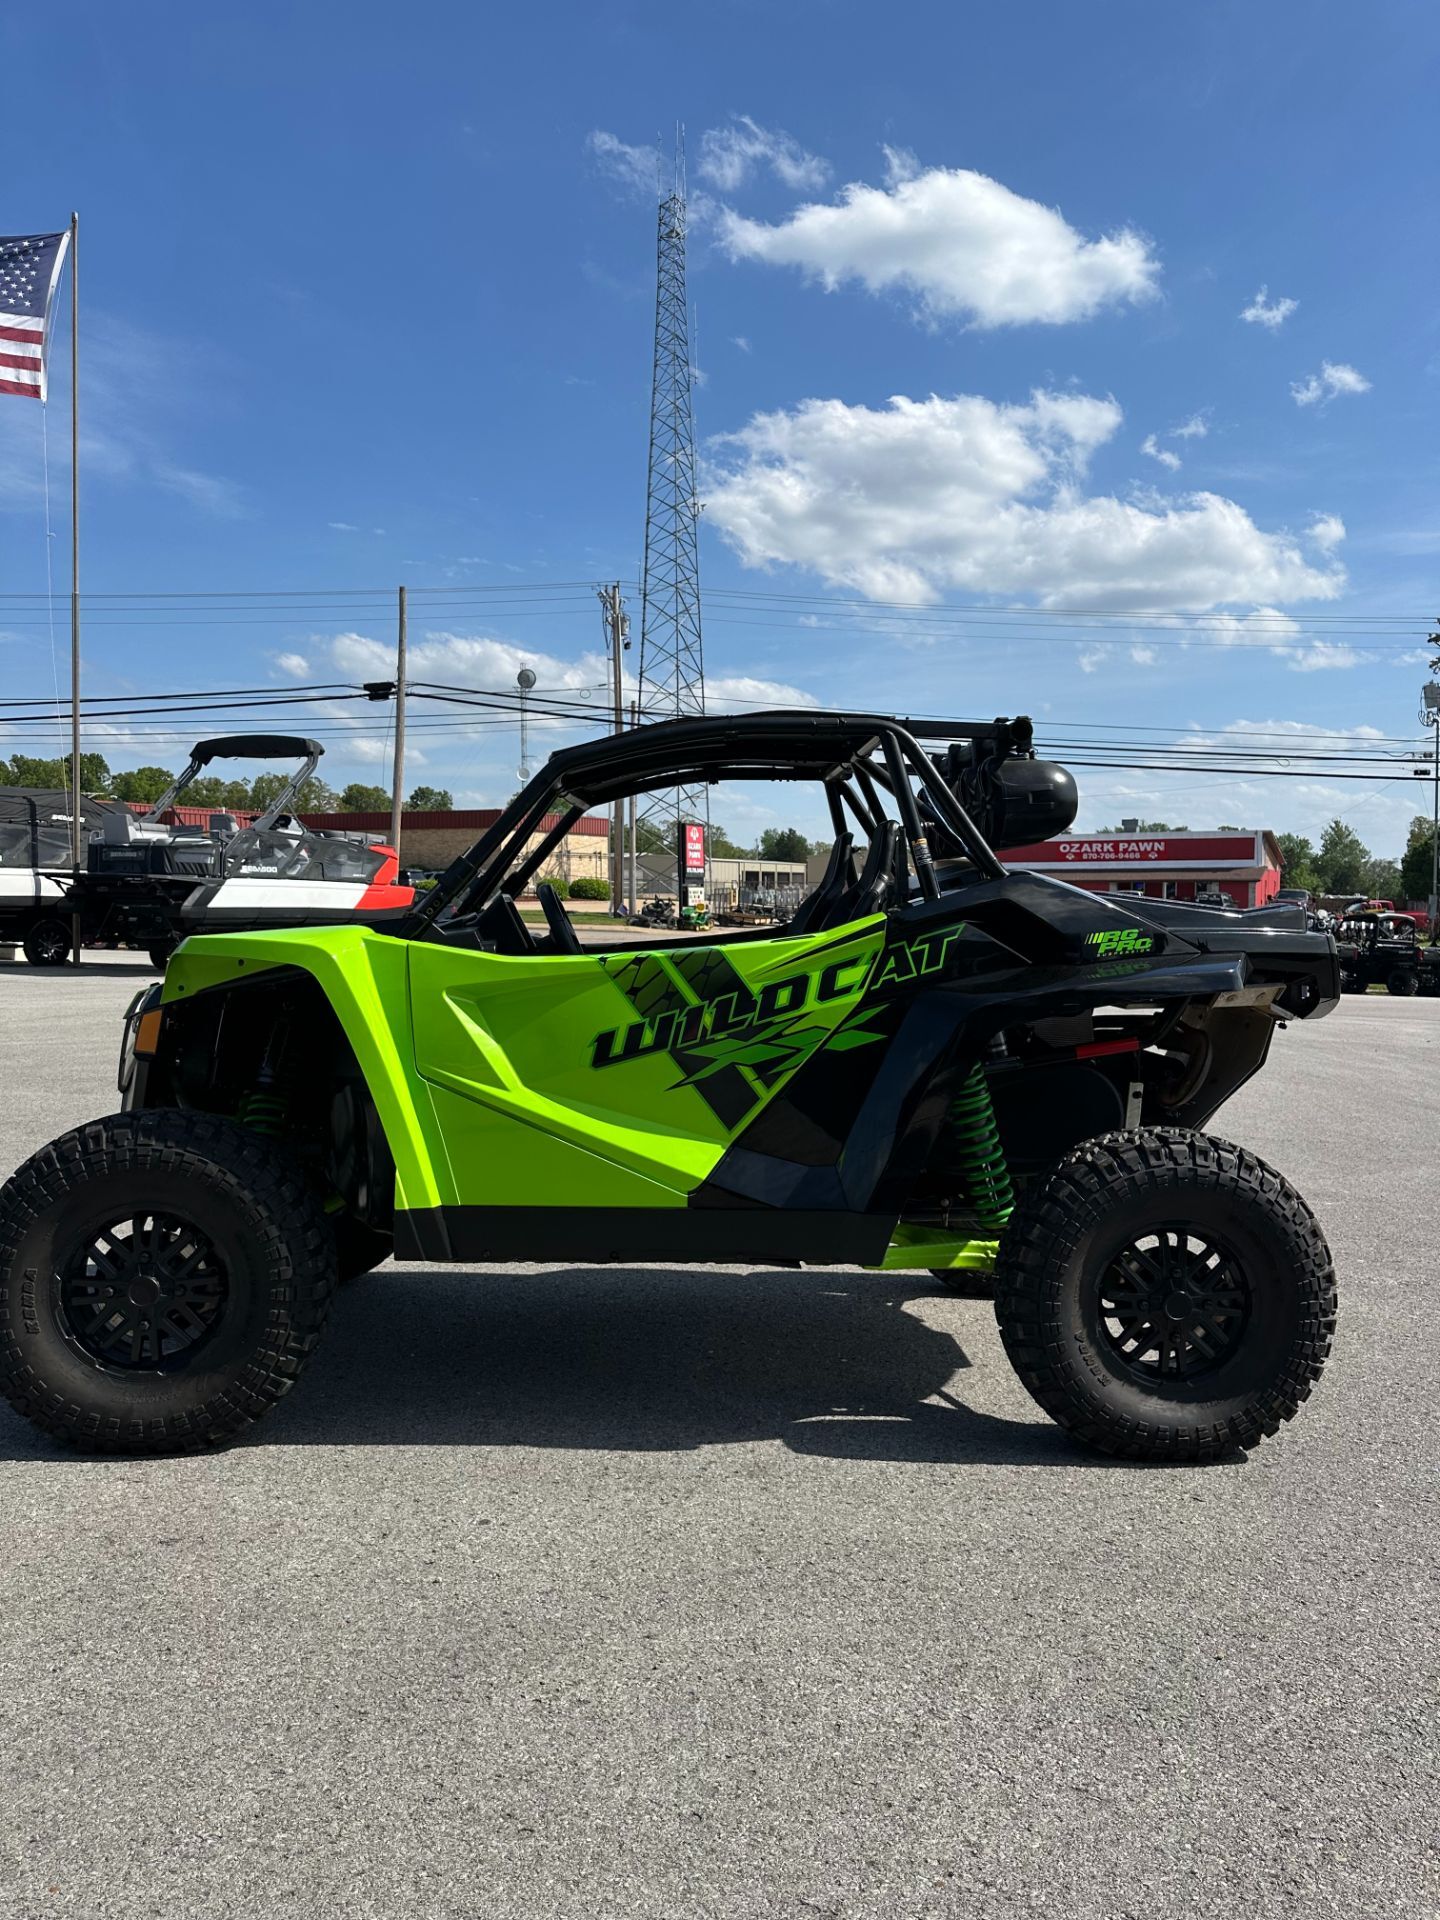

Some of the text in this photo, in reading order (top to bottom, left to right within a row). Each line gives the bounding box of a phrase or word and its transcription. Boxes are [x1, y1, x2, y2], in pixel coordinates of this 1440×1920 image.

[1060, 842, 1165, 853] OZARK PAWN
[1102, 929, 1139, 942] RG
[1098, 938, 1153, 954] PRO
[588, 921, 966, 1070] WILDCAT
[22, 1267, 41, 1334] KENDA
